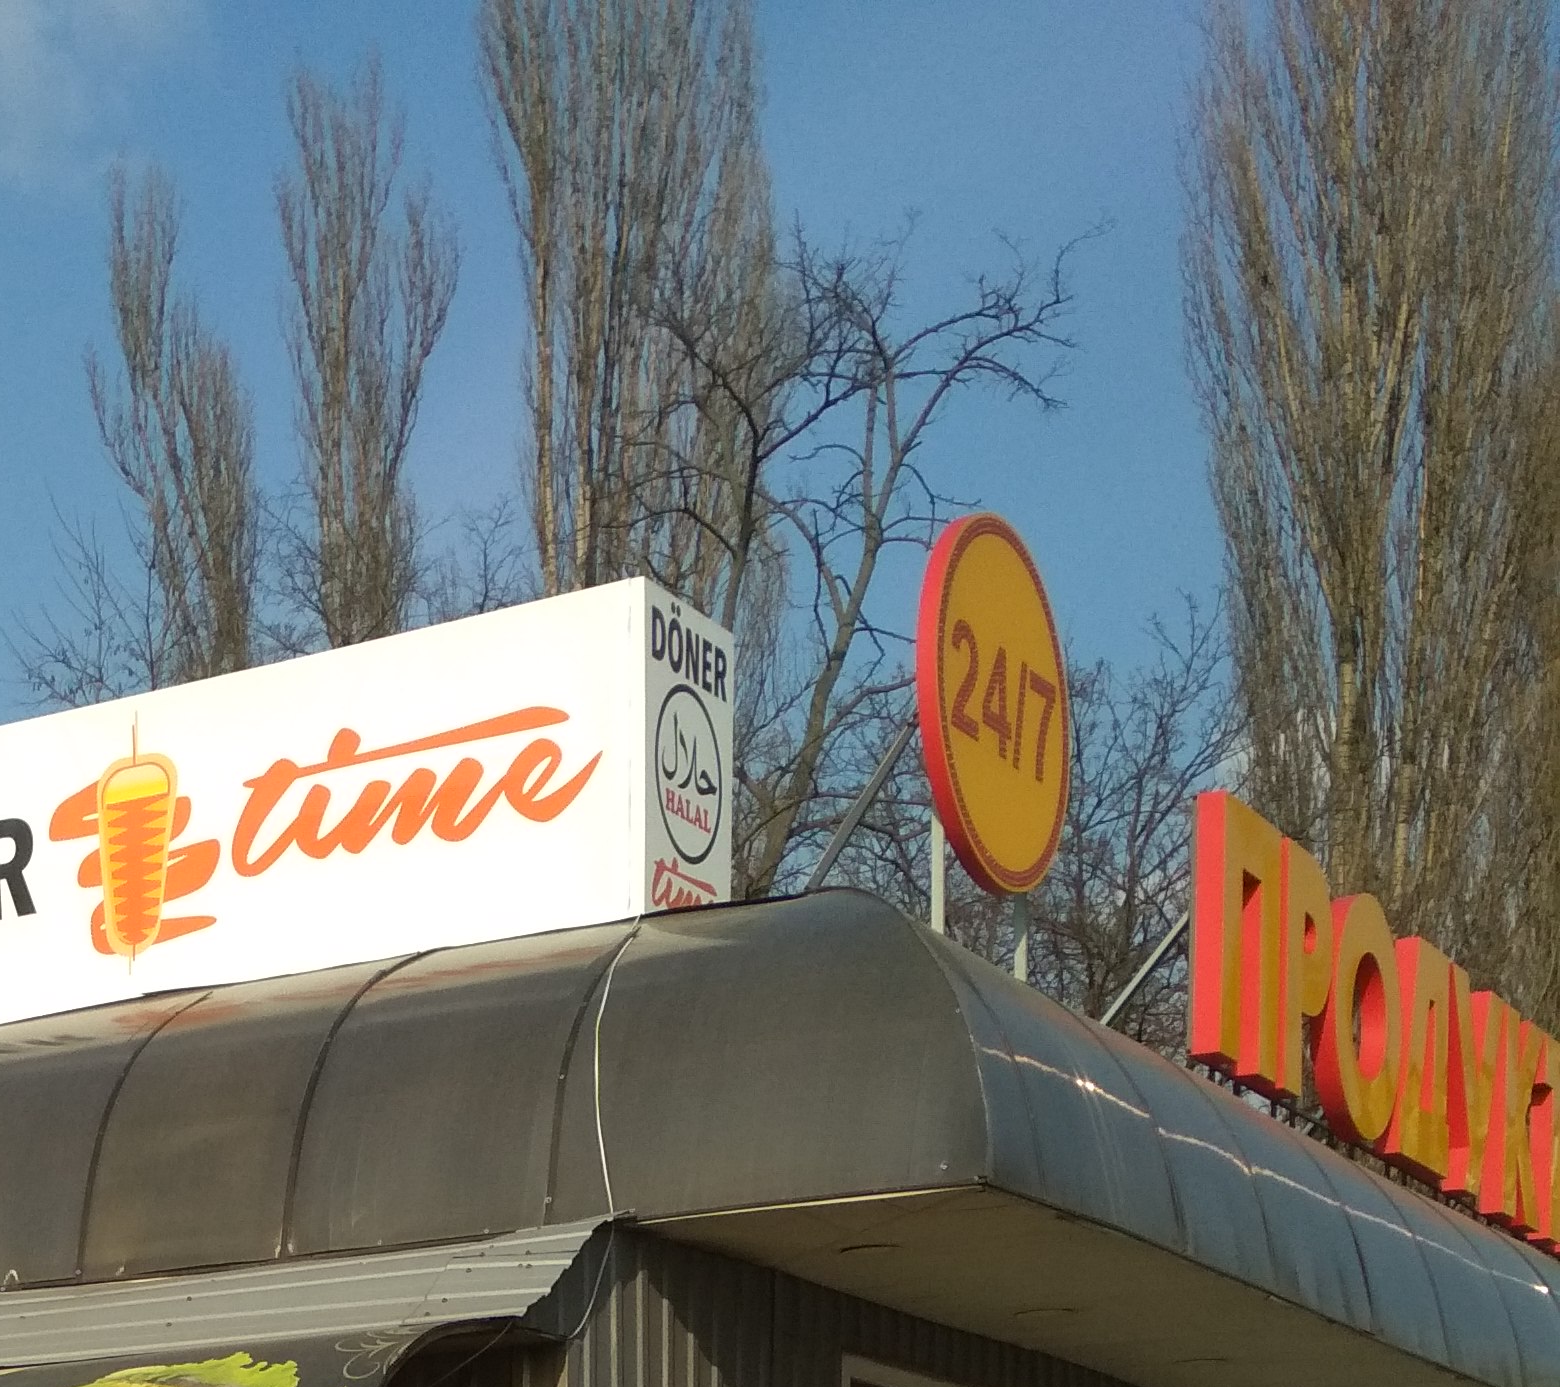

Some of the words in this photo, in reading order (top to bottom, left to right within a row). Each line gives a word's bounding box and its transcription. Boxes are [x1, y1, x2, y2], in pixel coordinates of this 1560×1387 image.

[652, 602, 728, 703] DÖNER
[951, 619, 1056, 783] 24/7
[231, 705, 604, 877] time
[665, 787, 712, 834] HALAL
[1191, 789, 1560, 1255] ПРОДУКТ
